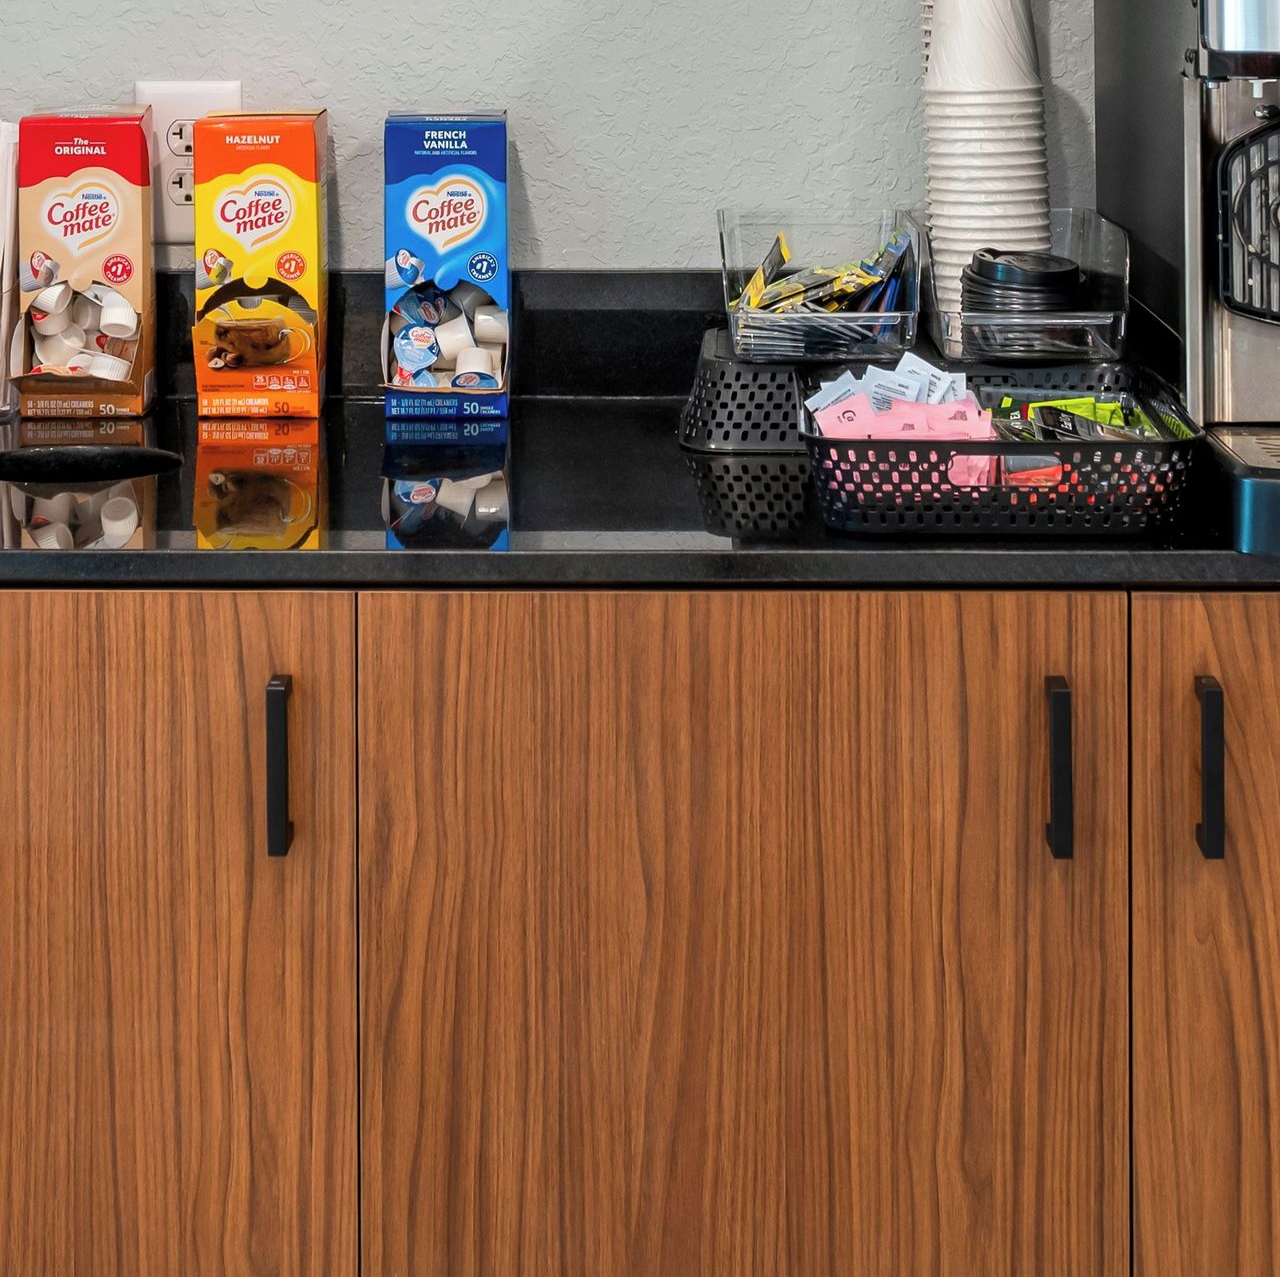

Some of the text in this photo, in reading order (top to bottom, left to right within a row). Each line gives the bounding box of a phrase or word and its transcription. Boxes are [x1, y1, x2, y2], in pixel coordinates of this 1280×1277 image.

[72, 137, 89, 145] The
[225, 135, 281, 144] HAZELNUT
[424, 130, 467, 140] FRENCH
[54, 146, 107, 155] ORIGINAL
[423, 140, 468, 149] VANILLA
[47, 201, 110, 226] Coffee
[220, 198, 282, 223] Coffee
[412, 198, 475, 223] Coffee
[63, 213, 112, 237] mate
[235, 210, 285, 235] mate
[428, 210, 477, 235] mate
[471, 254, 496, 268] AMERICA'S
[99, 404, 115, 415] 50
[274, 402, 290, 414] 50
[463, 402, 479, 414] 50
